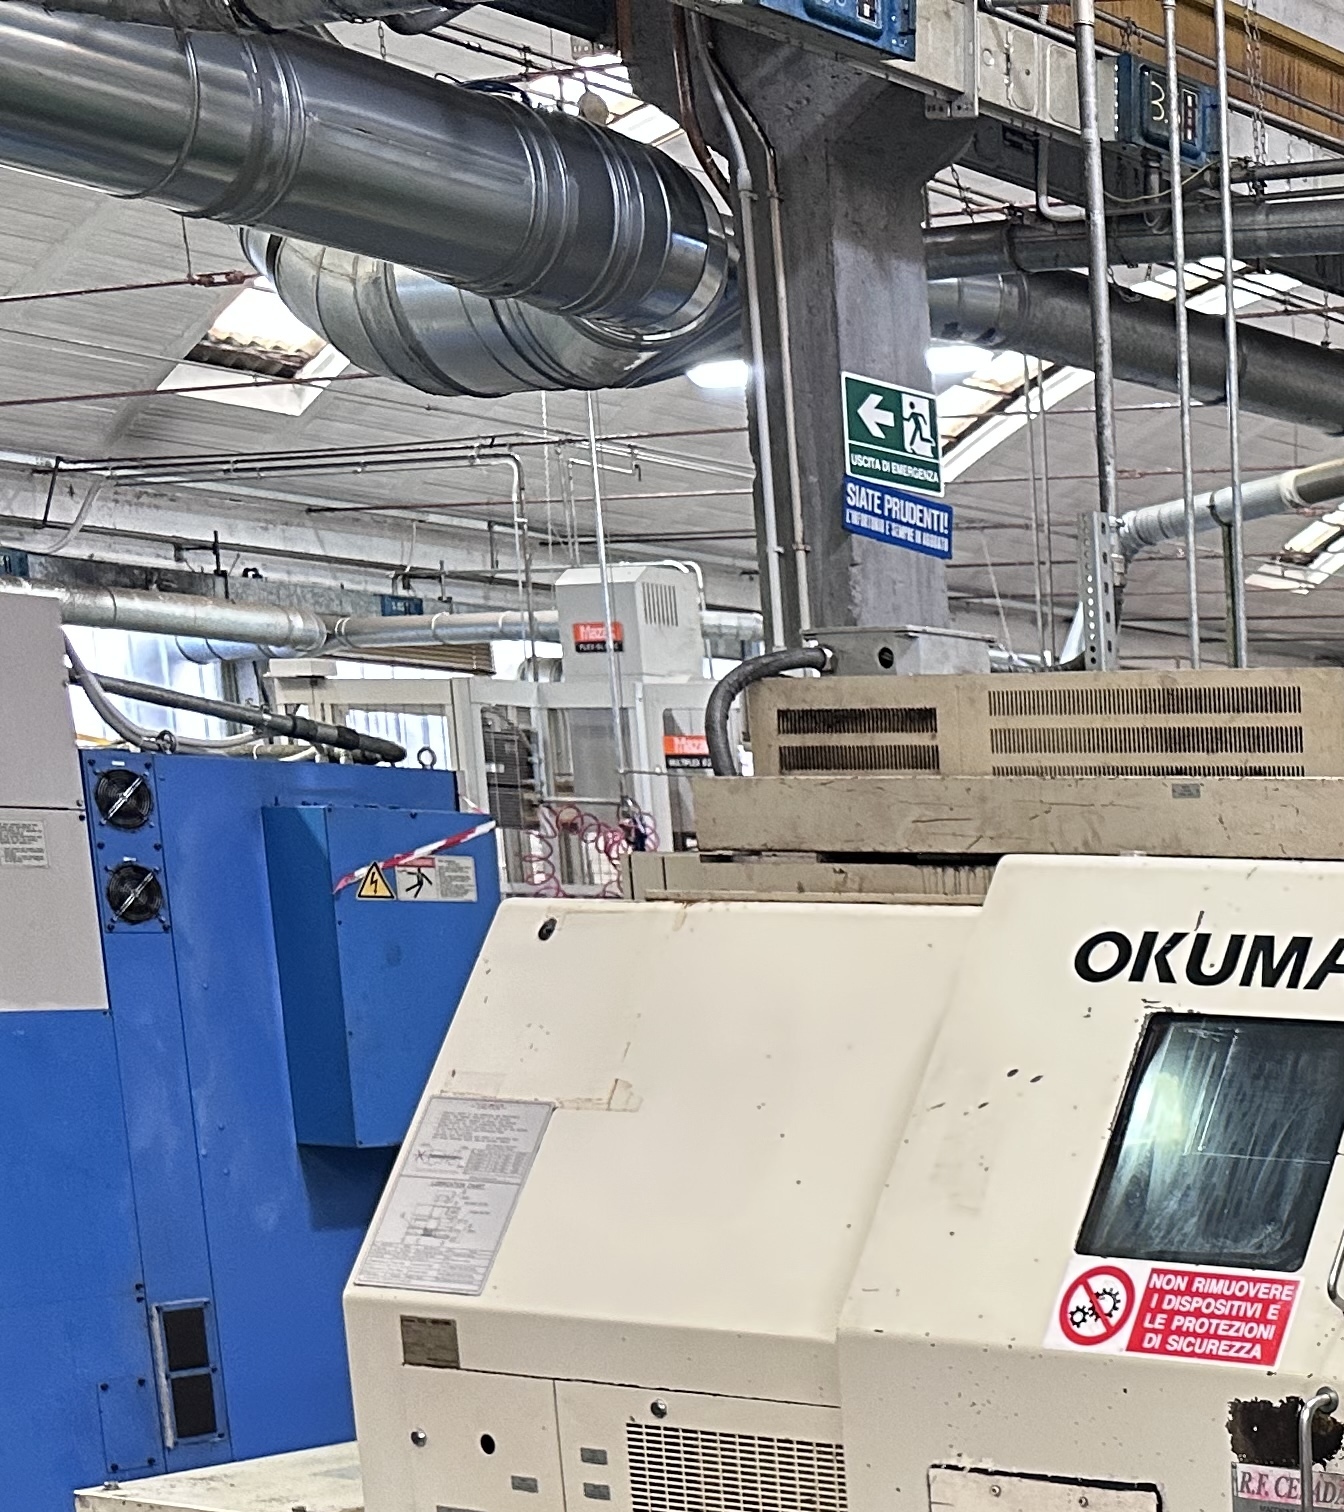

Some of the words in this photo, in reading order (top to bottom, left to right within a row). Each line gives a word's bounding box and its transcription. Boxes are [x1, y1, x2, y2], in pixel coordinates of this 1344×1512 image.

[851, 453, 880, 471] USCITA
[882, 460, 890, 472] DI
[891, 461, 939, 482] EMERGENZA
[846, 482, 882, 515] SIATE
[884, 494, 949, 534] PRUDENTI!
[1149, 1273, 1188, 1291] NON
[1191, 1277, 1295, 1300] RIMUOVERE
[1150, 1293, 1159, 1309] I
[1162, 1295, 1262, 1319] DISPOSITIVI
[1266, 1304, 1281, 1320] E
[1143, 1313, 1168, 1329] LE
[1171, 1315, 1276, 1340] PROTEZIONI
[1142, 1333, 1161, 1349] DI
[1166, 1335, 1262, 1359] SICUREZZA
[1239, 1471, 1269, 1497] R.F.
